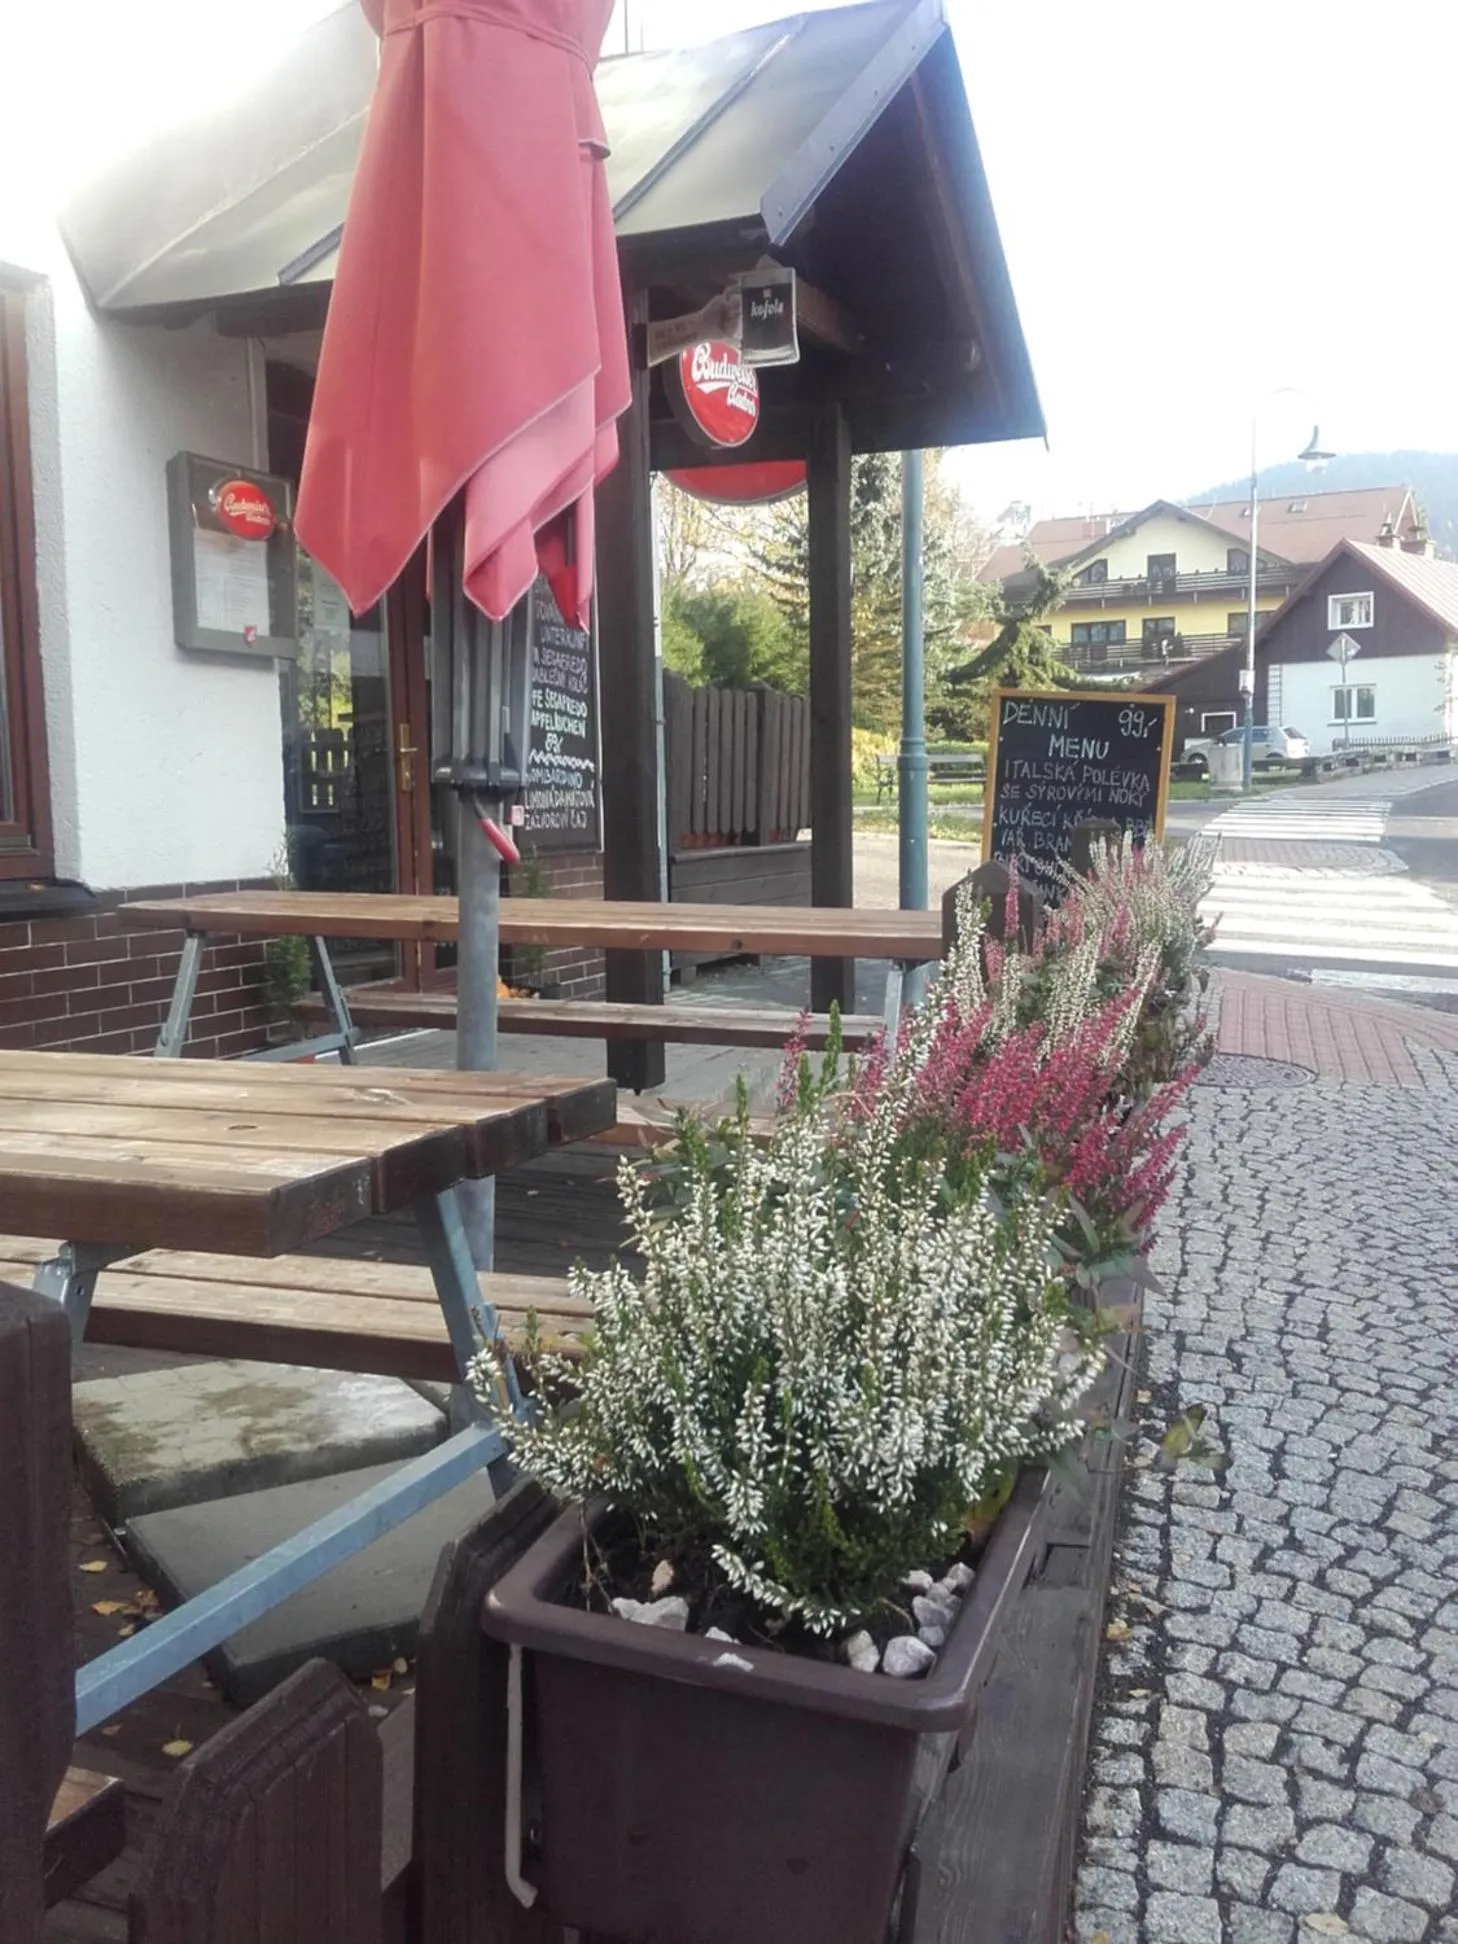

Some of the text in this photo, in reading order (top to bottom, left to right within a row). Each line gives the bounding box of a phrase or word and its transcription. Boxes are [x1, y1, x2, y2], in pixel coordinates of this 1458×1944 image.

[751, 298, 784, 320] kofola
[1002, 701, 1080, 730] DENNÍ
[1048, 734, 1110, 760] MENU
[1004, 759, 1151, 792] ITALSKÁ POLÉVKA
[1000, 783, 1021, 800] SE
[998, 802, 1062, 828] KUŘECÍ
